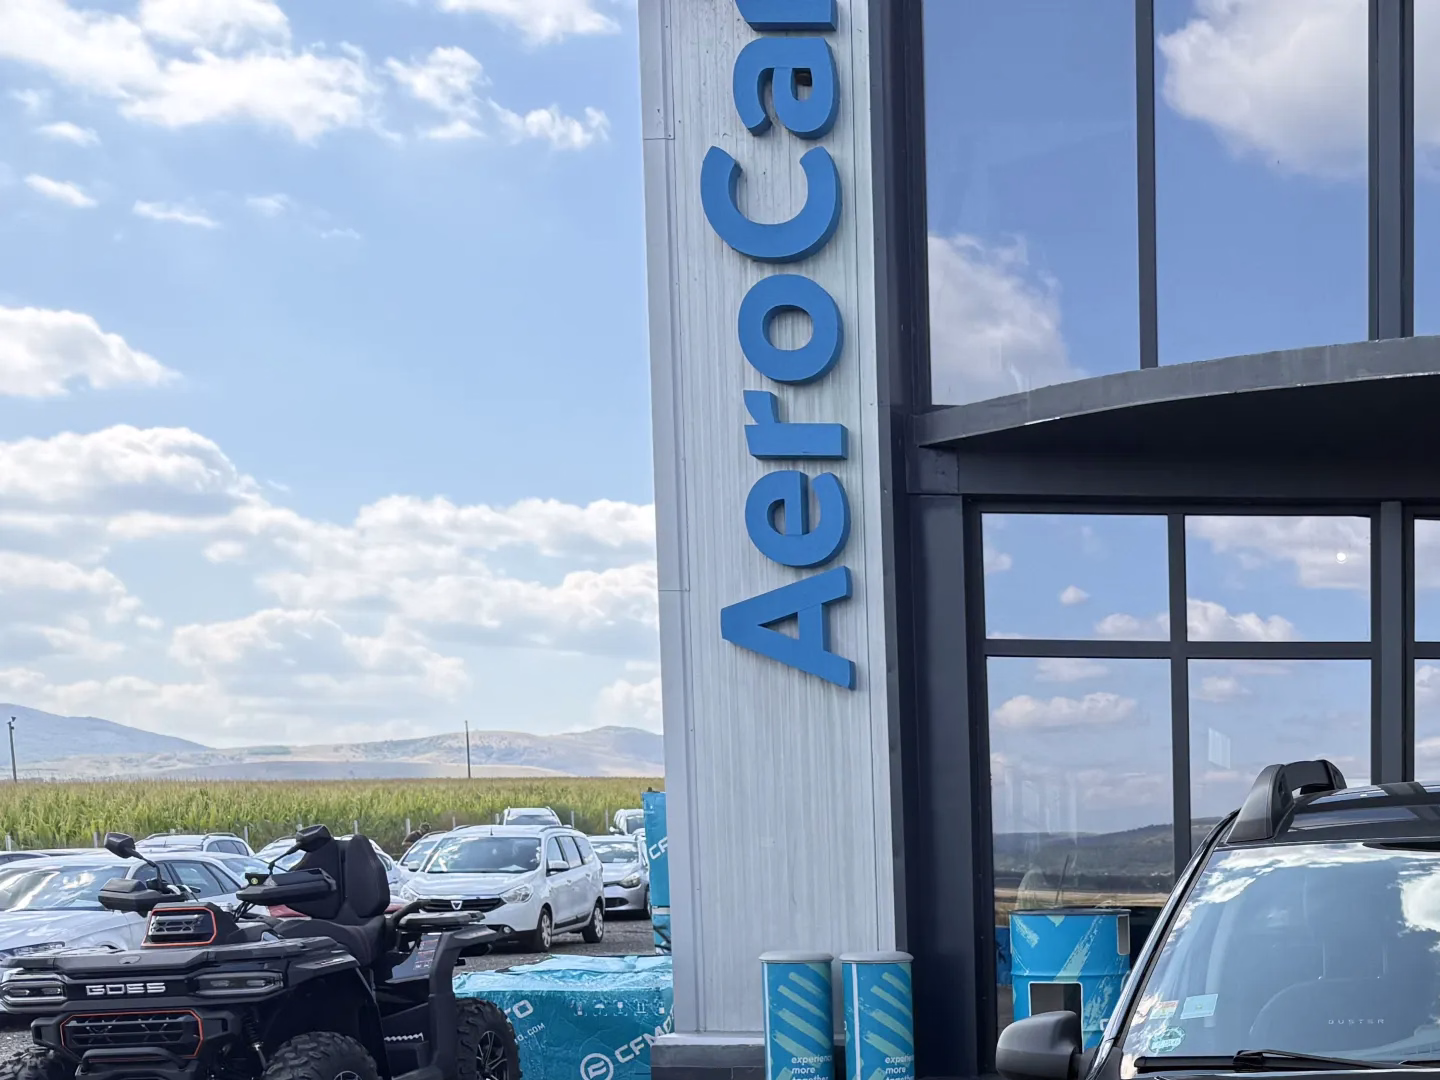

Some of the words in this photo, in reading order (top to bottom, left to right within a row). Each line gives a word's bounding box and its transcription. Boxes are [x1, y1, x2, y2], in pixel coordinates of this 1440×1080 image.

[86, 982, 166, 996] GOES
[791, 1067, 816, 1075] more
[885, 1066, 906, 1075] more
